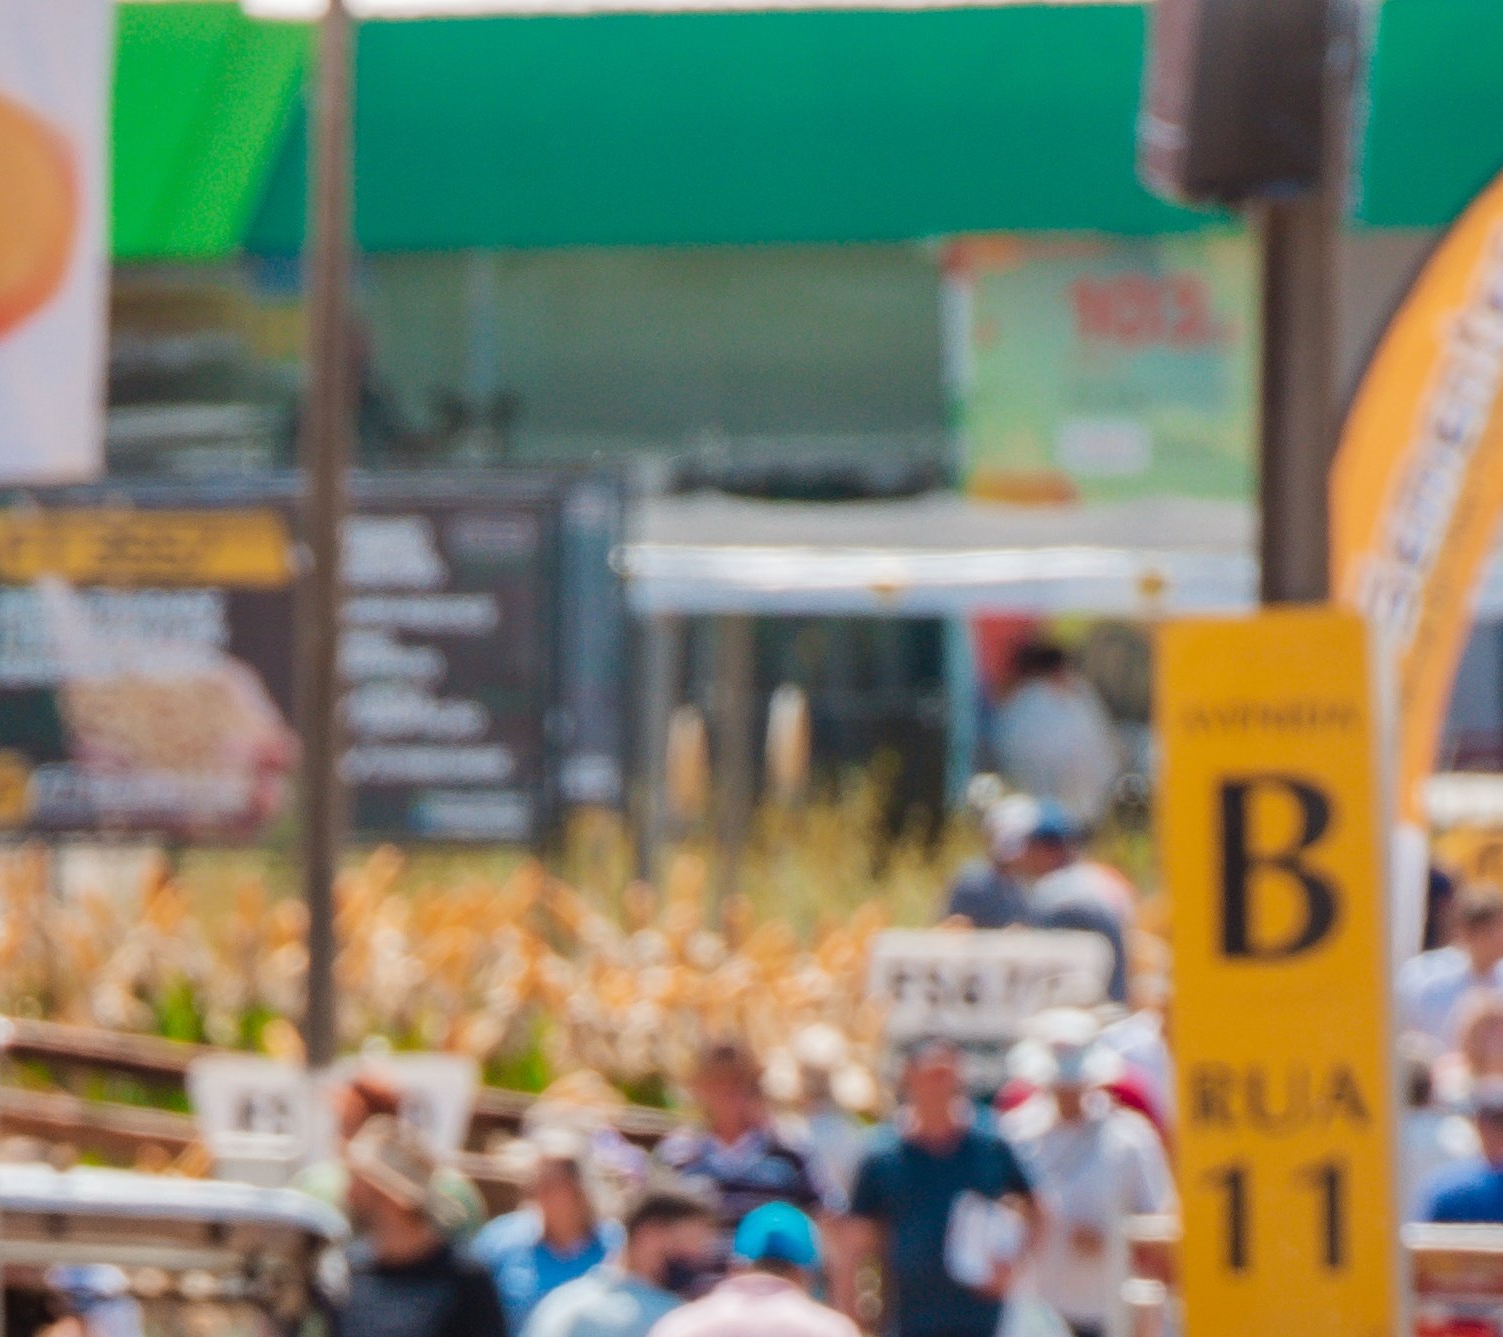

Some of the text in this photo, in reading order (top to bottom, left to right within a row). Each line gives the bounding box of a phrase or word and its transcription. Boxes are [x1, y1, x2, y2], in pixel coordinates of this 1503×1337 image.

[1217, 774, 1339, 961] B
[1191, 1060, 1370, 1132] RUA
[1200, 1156, 1349, 1276] 11
